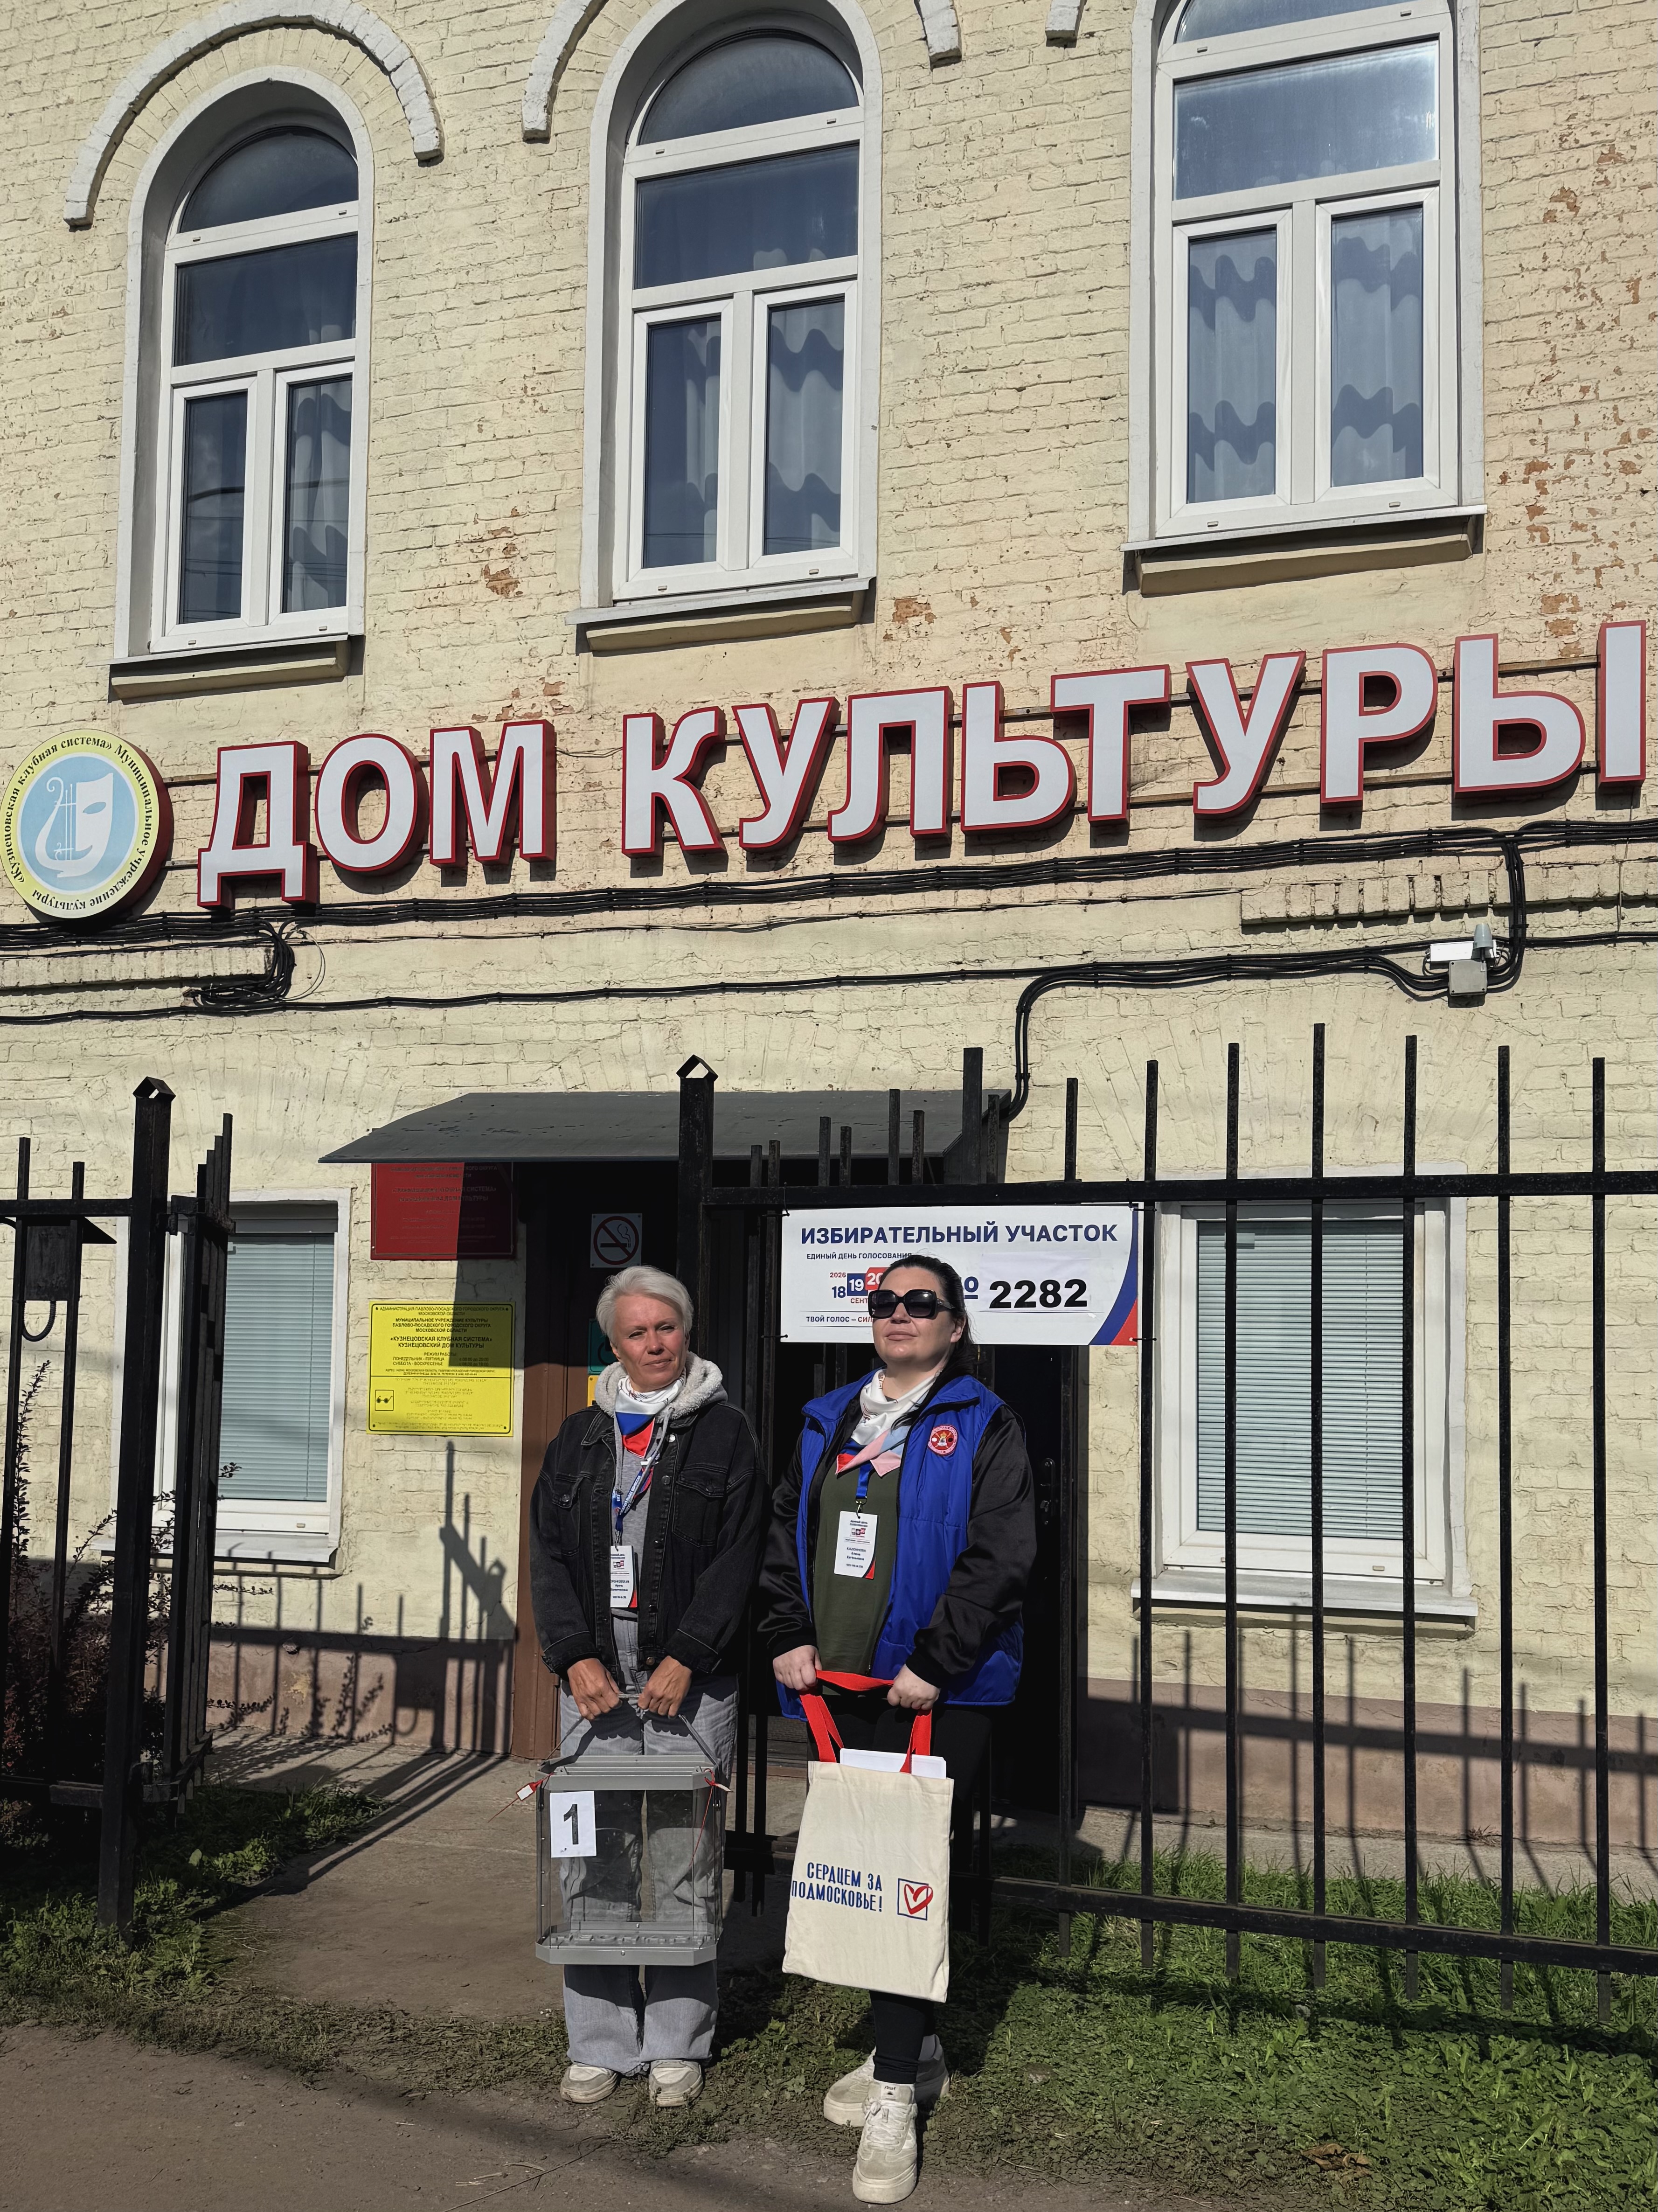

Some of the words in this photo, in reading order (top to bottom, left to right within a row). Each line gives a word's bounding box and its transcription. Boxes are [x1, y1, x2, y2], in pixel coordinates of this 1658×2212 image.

[61, 736, 112, 751] система»
[18, 745, 58, 786] клубная
[198, 719, 555, 907] ДОМ
[622, 620, 1647, 858] КУЛЬТУРЫ
[114, 744, 153, 846] Муниципальное
[4, 787, 25, 883] «Кузнецовская
[90, 847, 141, 907] учреждение
[32, 889, 86, 910] культуры
[801, 1221, 998, 1244] ИЗБИРАТЕЛЬНЫЙ
[1005, 1224, 1118, 1243] УЧАСТОК
[832, 1286, 846, 1298] 18
[849, 1279, 864, 1292] 19
[989, 1279, 1088, 1309] 2282
[563, 1803, 579, 1845] 1
[807, 1862, 861, 1887] СЕРДЦЕМ
[867, 1873, 883, 1892] ЗА
[791, 1880, 882, 1913] ПОДМОСКОВЬЕ!
